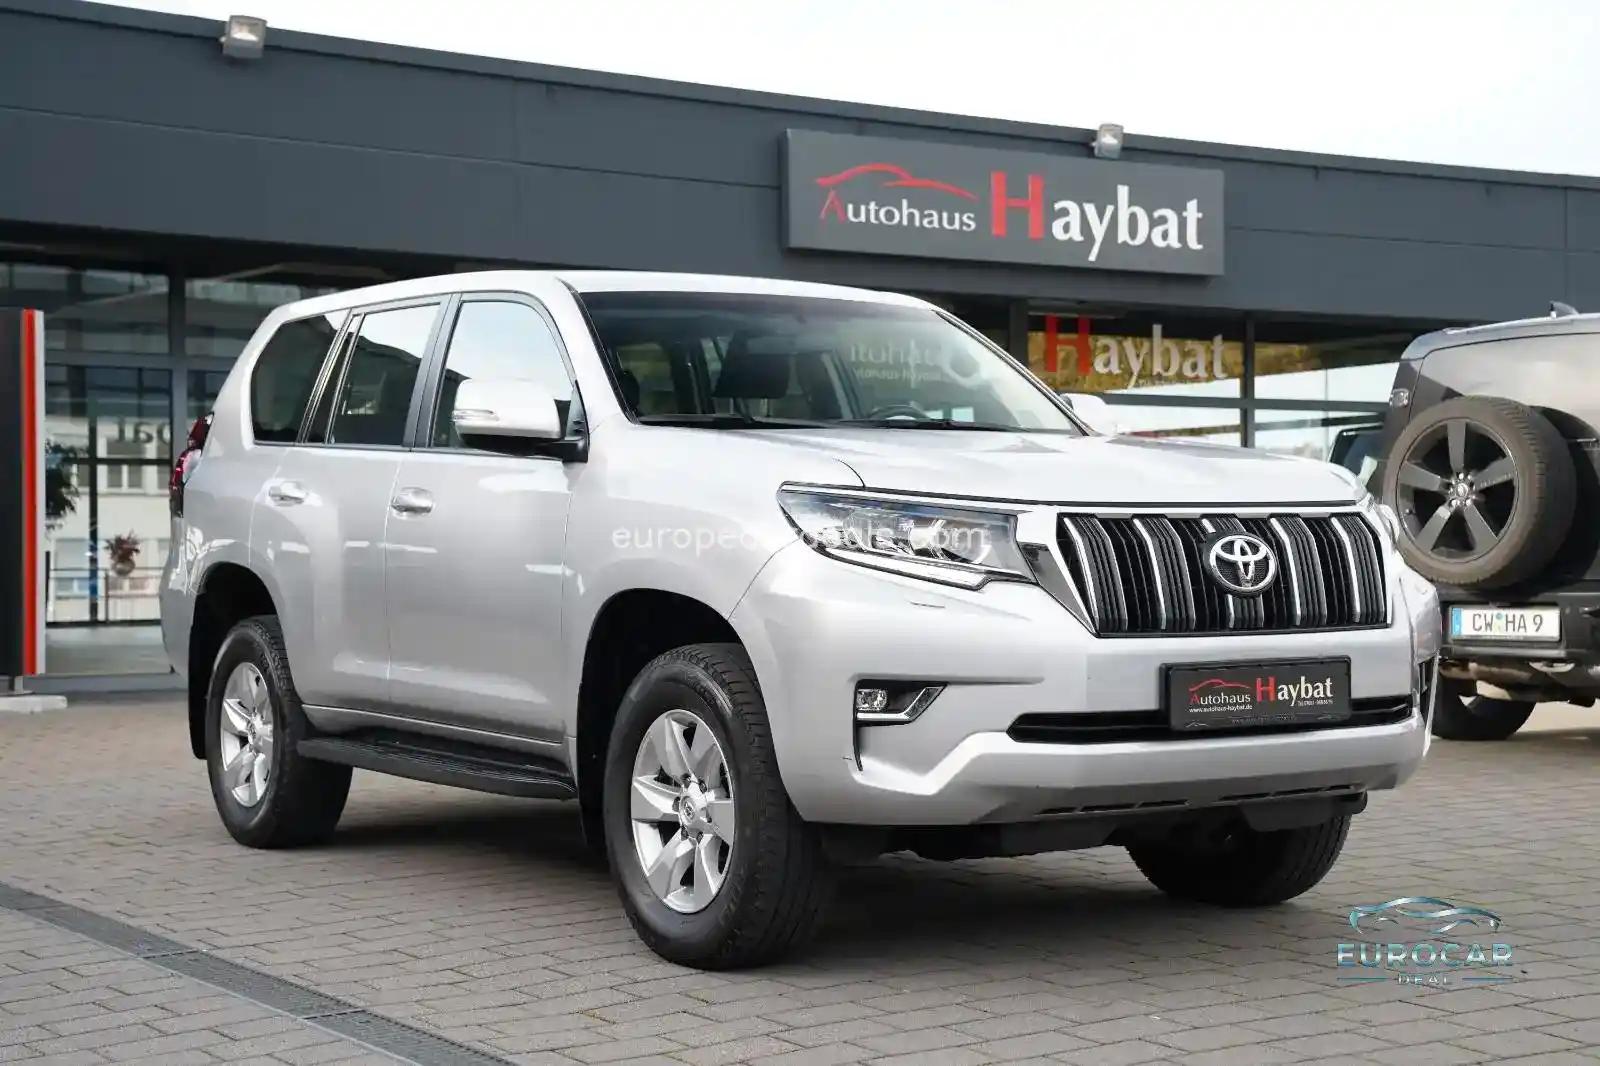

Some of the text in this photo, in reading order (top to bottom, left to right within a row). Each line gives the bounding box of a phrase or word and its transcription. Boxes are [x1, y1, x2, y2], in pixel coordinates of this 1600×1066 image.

[820, 170, 1204, 262] Autohaus Haybat
[1043, 314, 1229, 389] Haybat
[1472, 613, 1543, 633] CW HA 9
[1190, 676, 1333, 707] Autohaus Haybat
